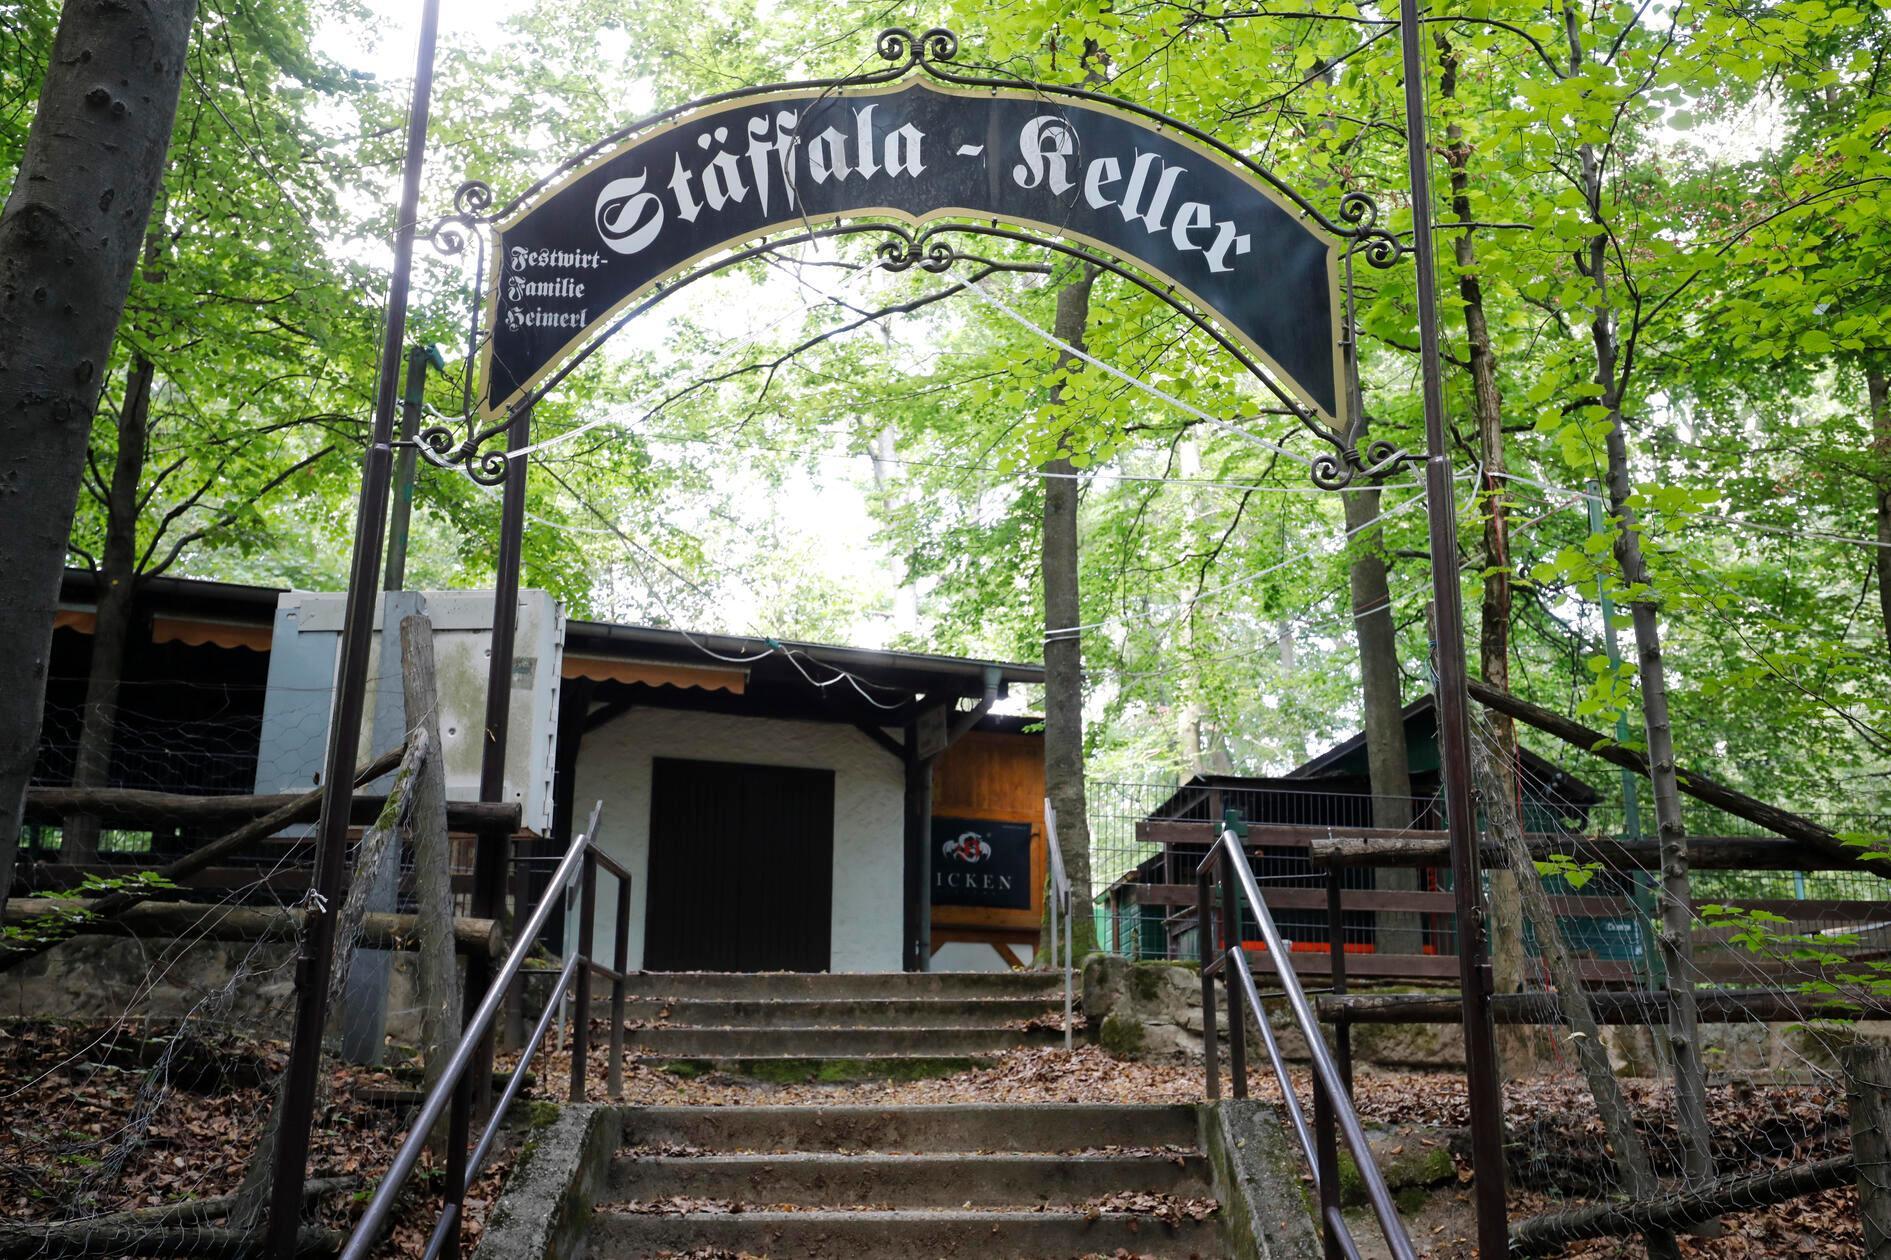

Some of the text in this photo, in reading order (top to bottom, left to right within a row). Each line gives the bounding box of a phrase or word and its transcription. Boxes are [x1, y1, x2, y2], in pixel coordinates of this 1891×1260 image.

[595, 104, 1251, 273] Stäffala - Keller
[511, 246, 608, 272] Festwirt-
[508, 276, 585, 302] Familie
[505, 307, 588, 332] Heimerl
